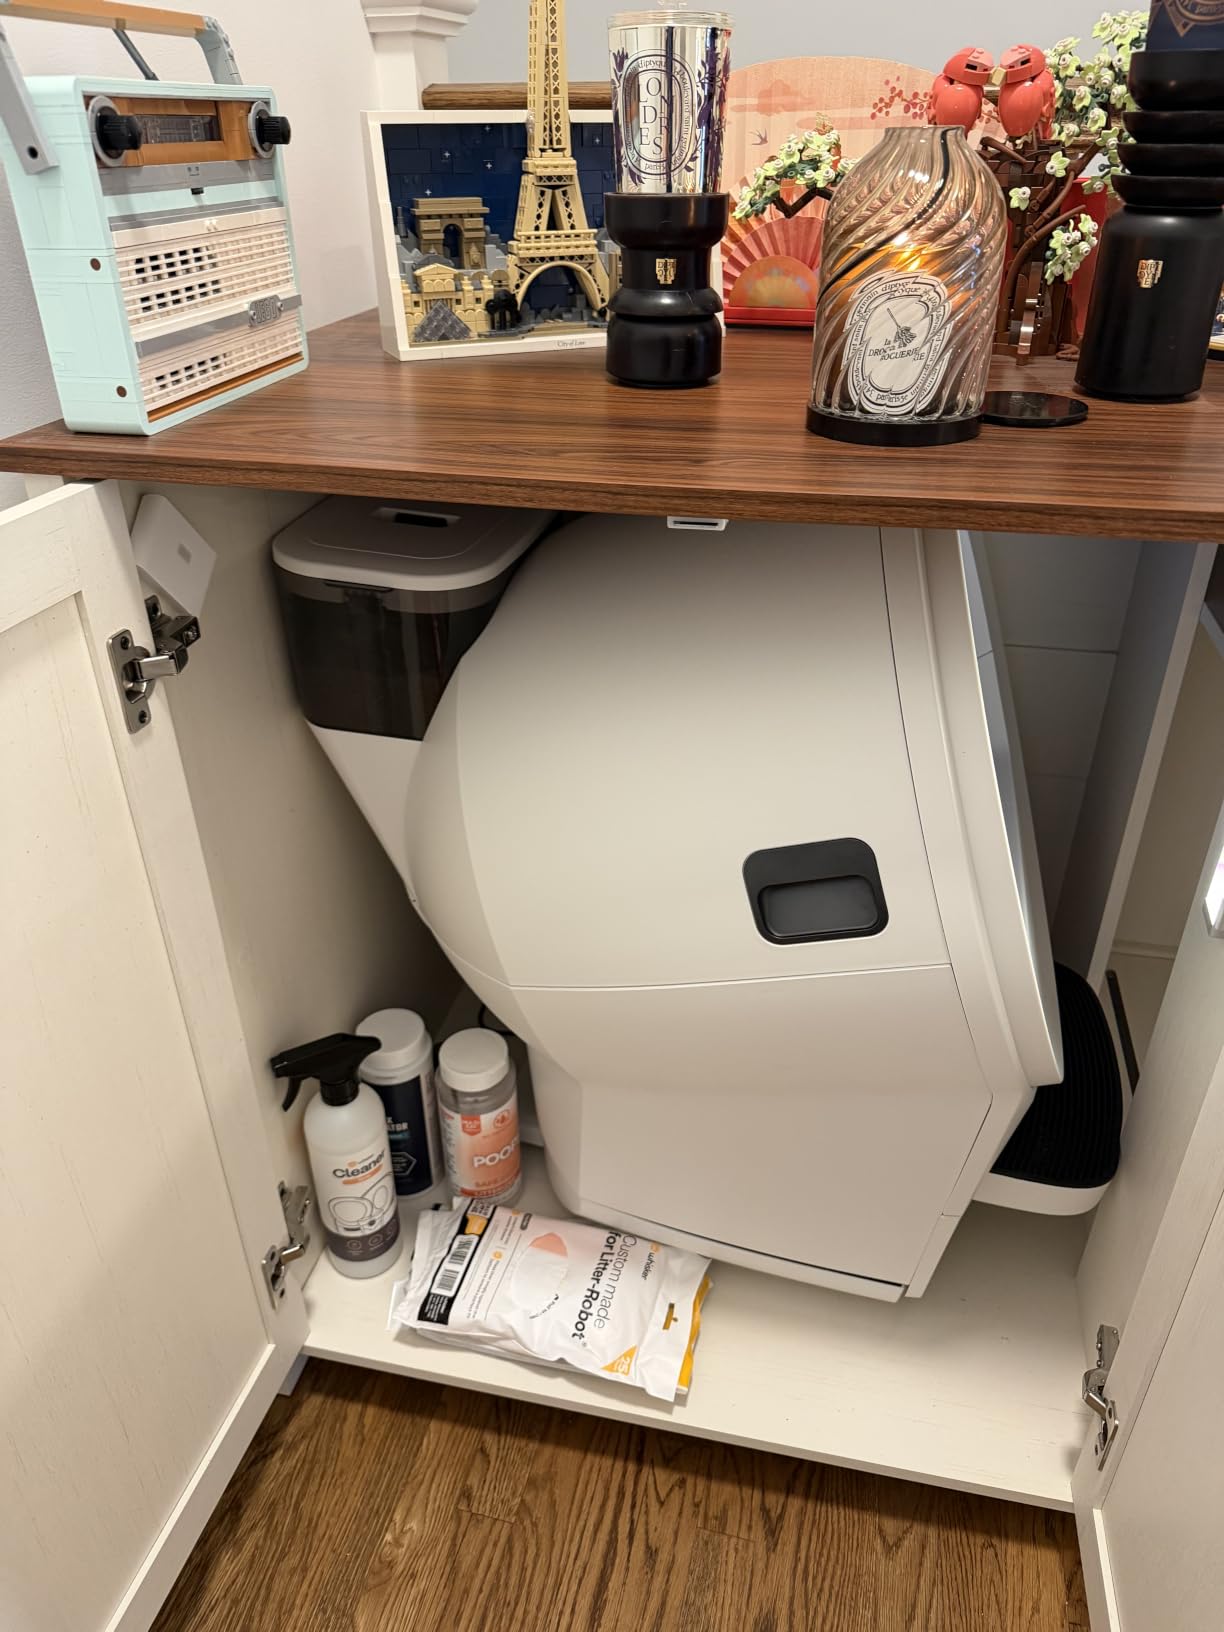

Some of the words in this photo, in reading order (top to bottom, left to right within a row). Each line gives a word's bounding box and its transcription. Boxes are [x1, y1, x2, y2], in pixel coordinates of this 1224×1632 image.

[332, 1148, 385, 1178] Cleaner
[604, 1231, 622, 1251] for
[608, 1234, 637, 1282] Custom
[641, 1251, 655, 1280] whisker
[594, 1283, 617, 1329] made
